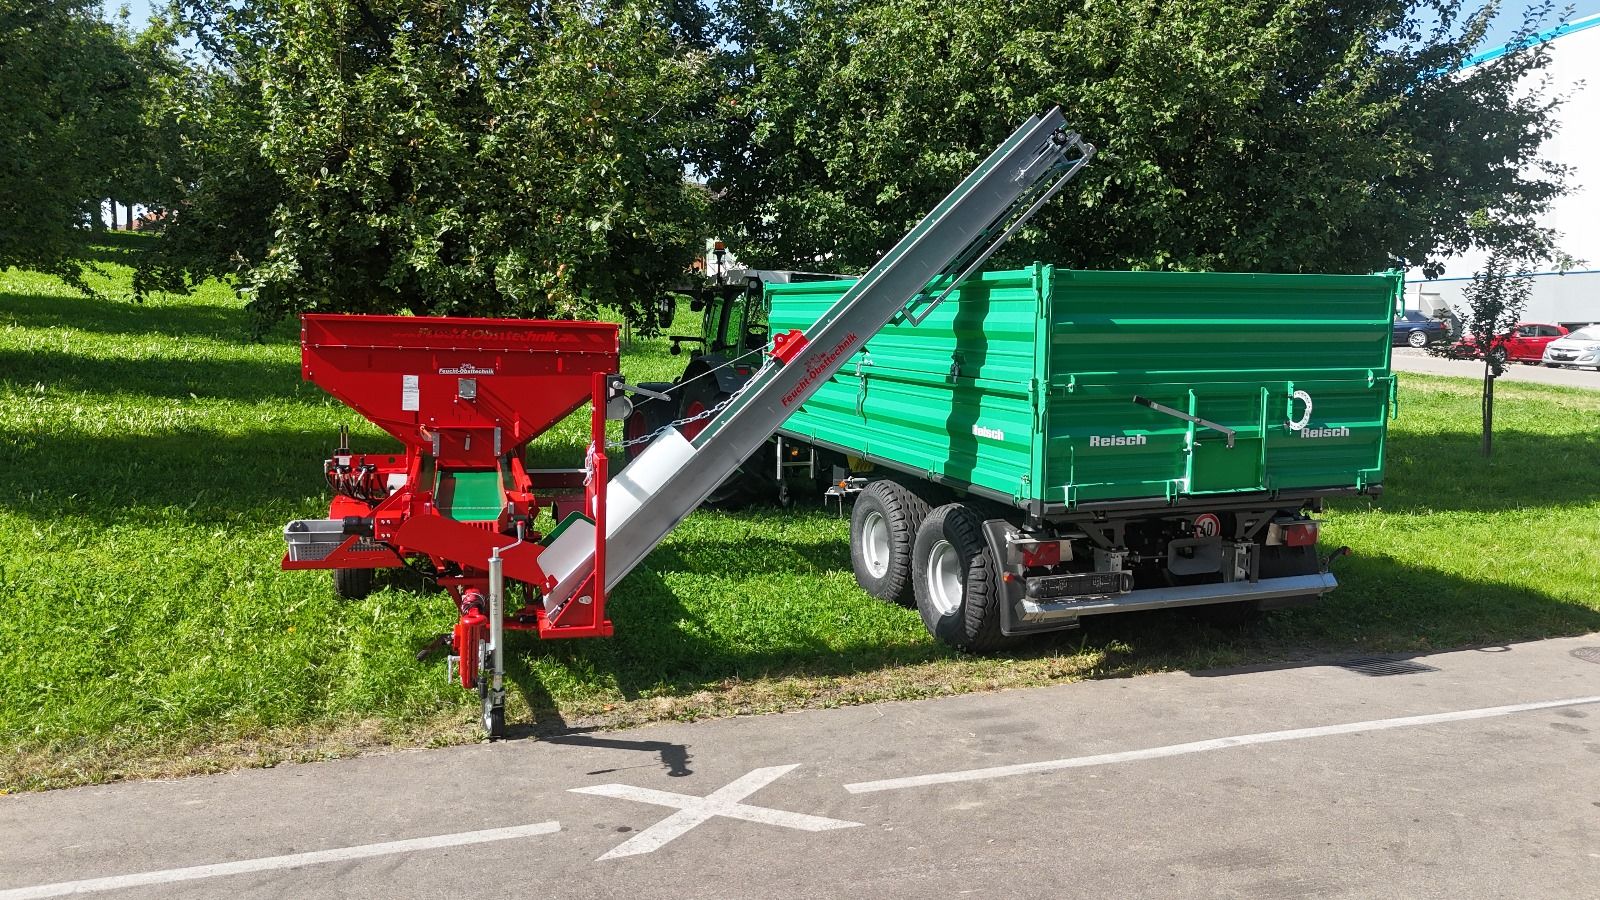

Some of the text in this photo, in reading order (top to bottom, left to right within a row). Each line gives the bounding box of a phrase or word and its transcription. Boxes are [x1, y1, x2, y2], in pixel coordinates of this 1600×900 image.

[782, 332, 858, 407] Feucht-Obsttechnik
[971, 424, 1005, 441] Reisch
[1301, 426, 1350, 438] Reisch
[1089, 434, 1147, 447] Reisch
